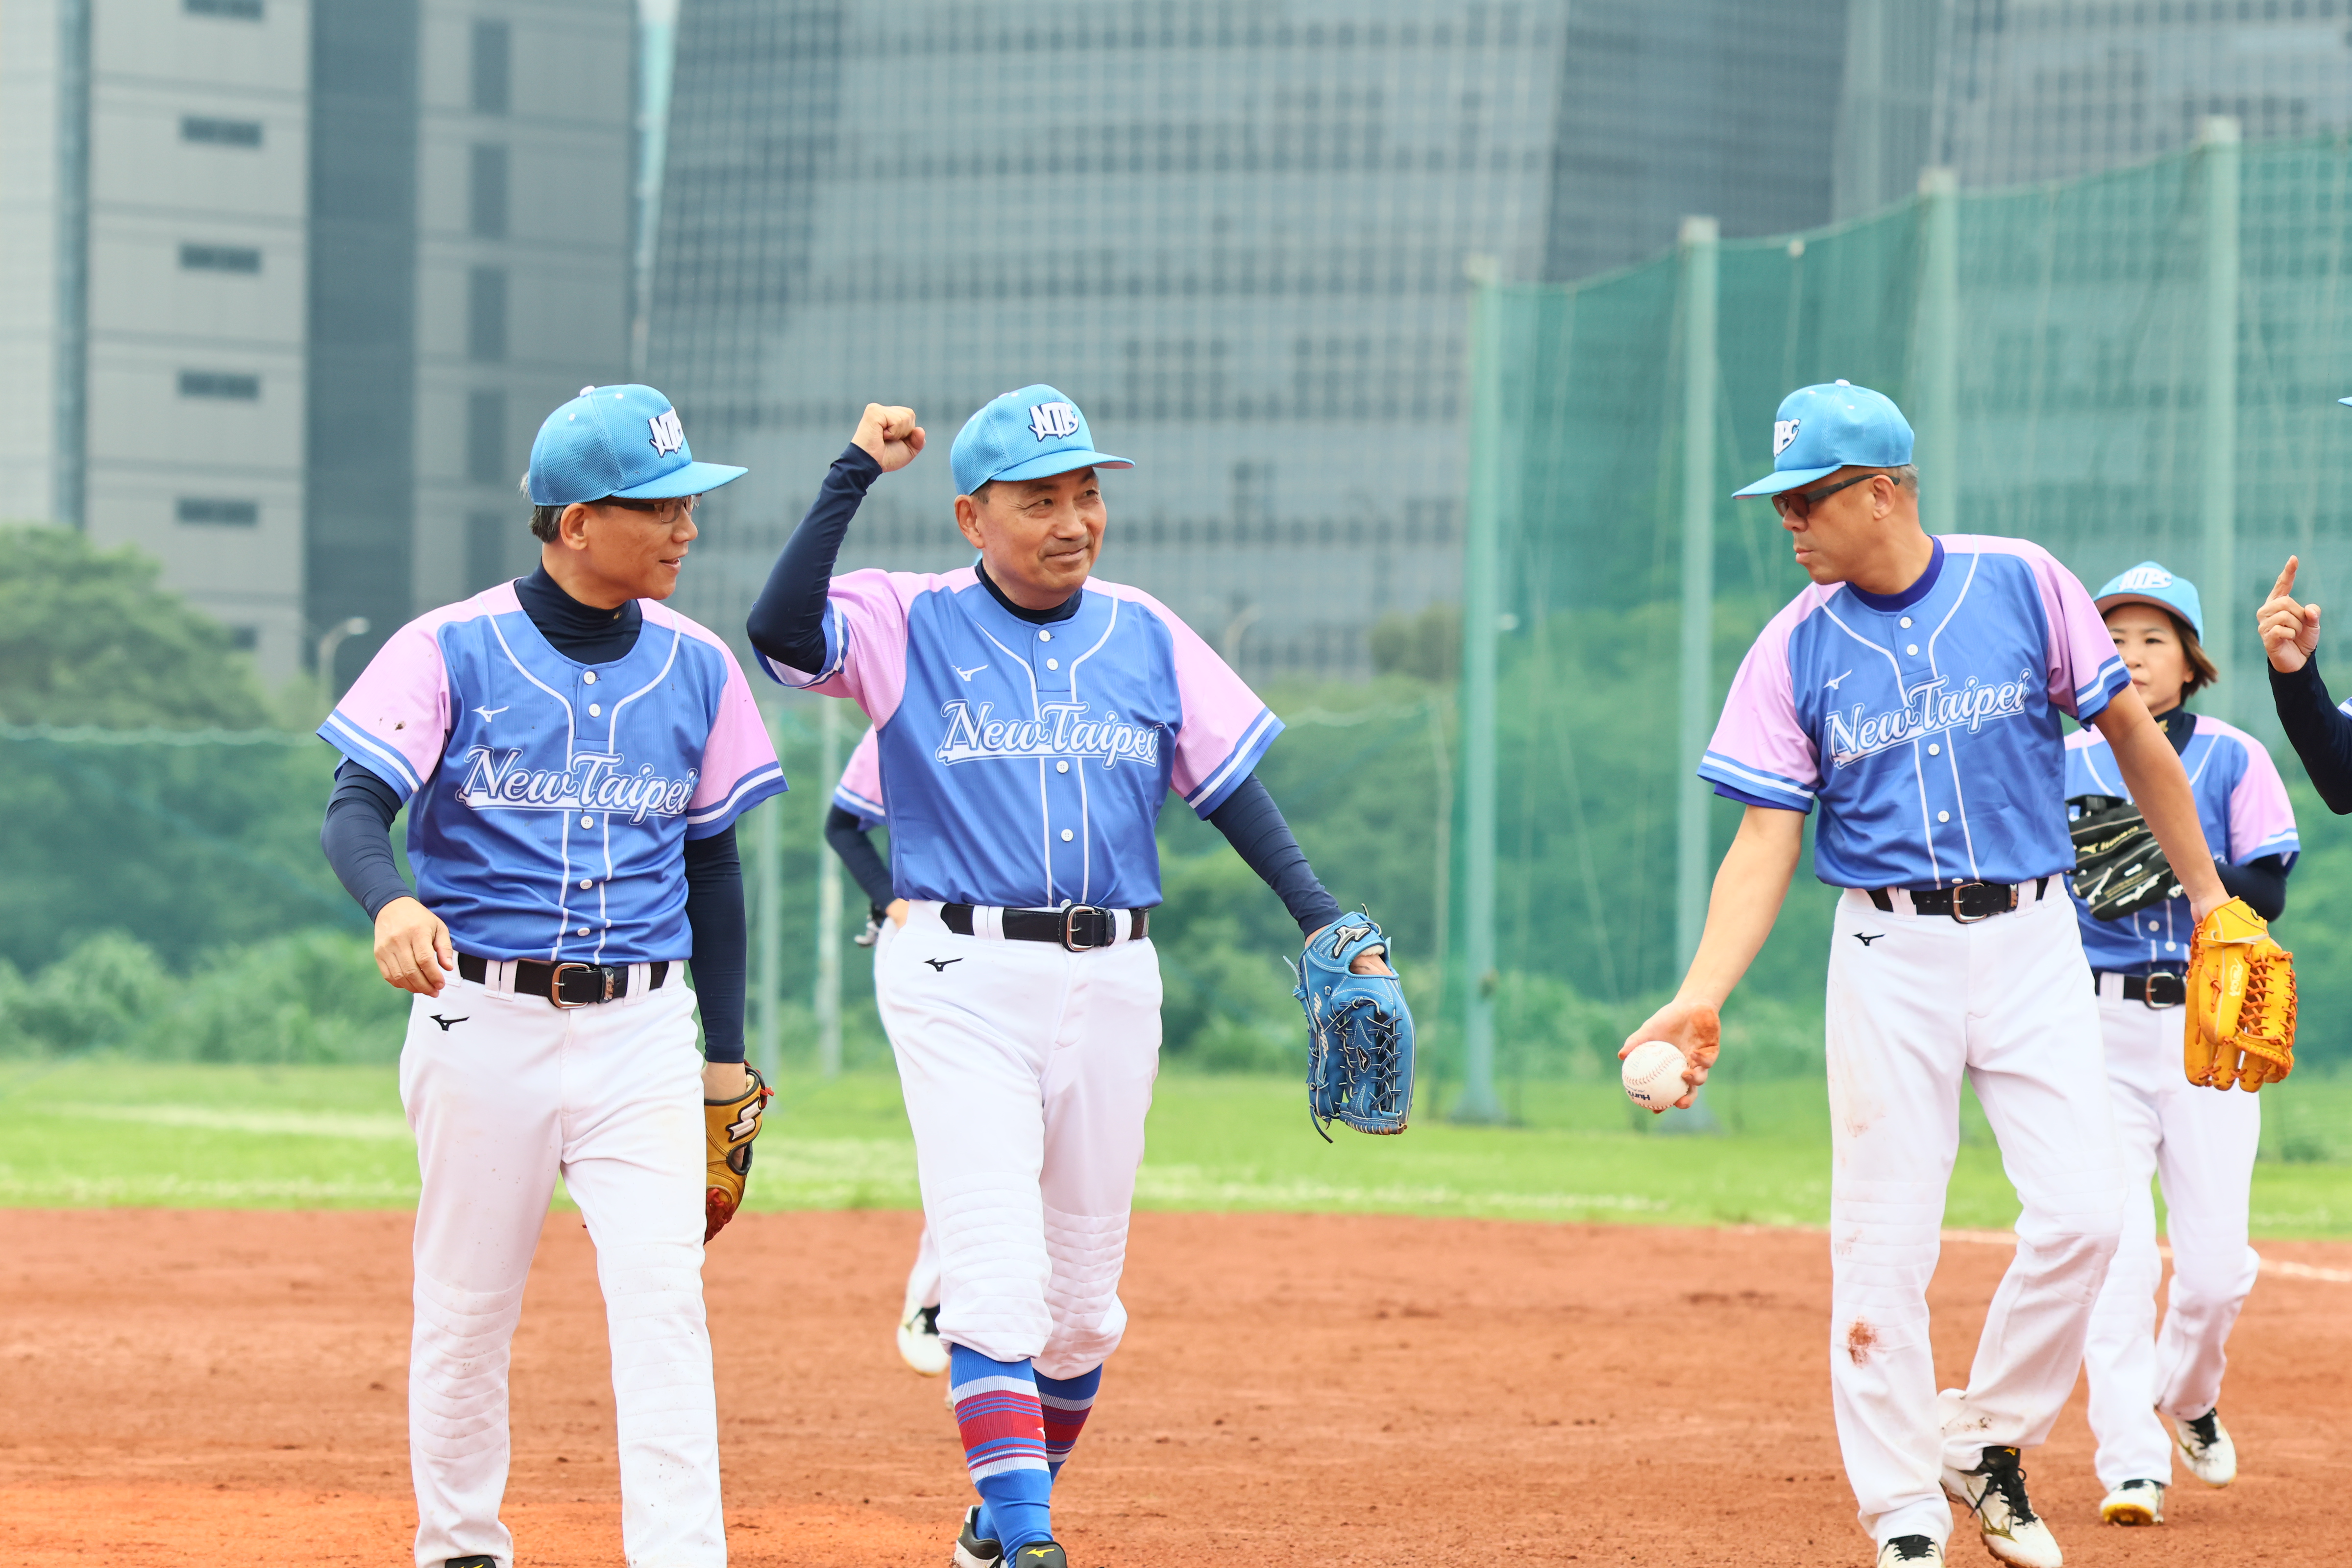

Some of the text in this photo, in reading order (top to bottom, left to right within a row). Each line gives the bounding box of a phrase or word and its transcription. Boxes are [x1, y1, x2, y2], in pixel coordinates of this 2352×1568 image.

[2118, 567, 2173, 591] NTPC
[941, 699, 1166, 770] New Taipei
[1825, 668, 2032, 757] New Taipei
[464, 744, 698, 825] New Taipei
[604, 971, 614, 1001] TPX
